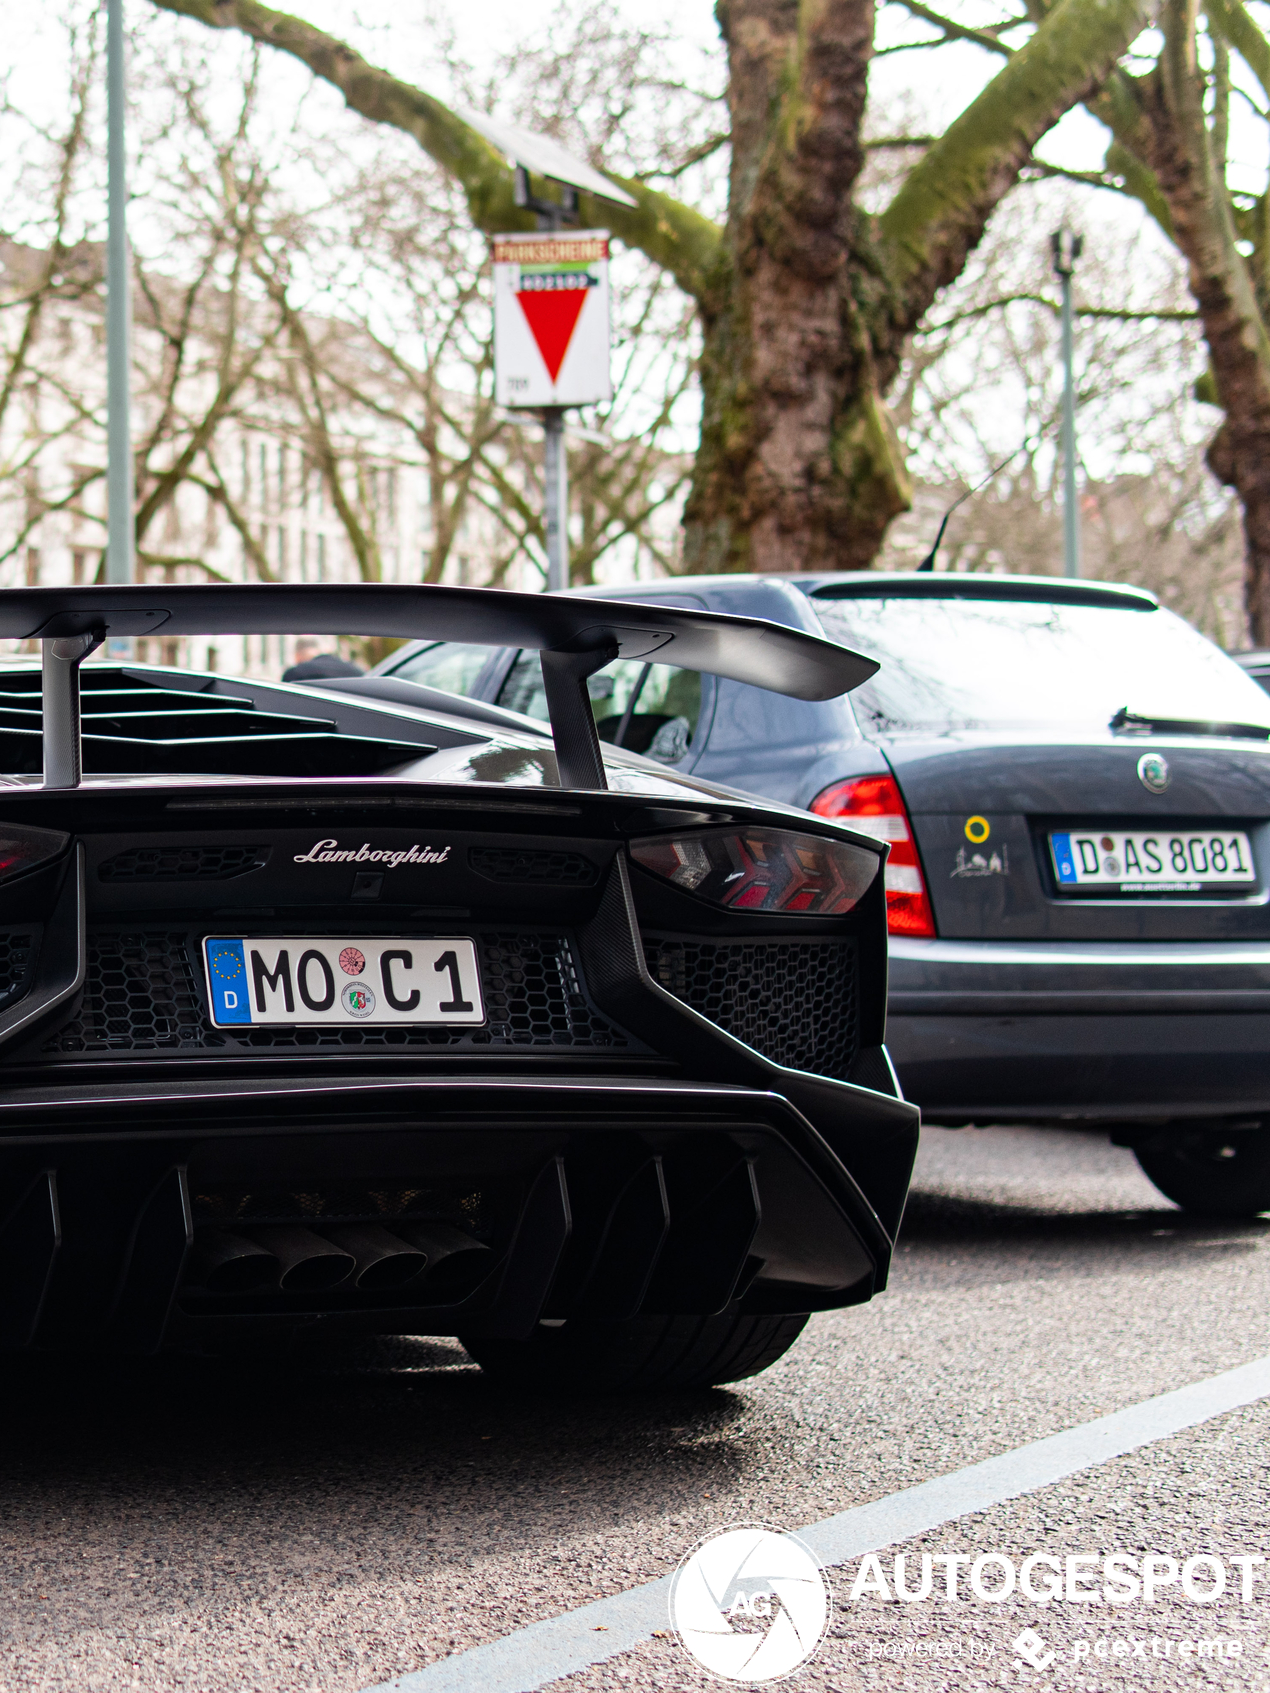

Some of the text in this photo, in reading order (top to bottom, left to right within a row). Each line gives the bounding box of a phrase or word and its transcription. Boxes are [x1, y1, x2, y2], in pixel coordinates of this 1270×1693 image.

[497, 241, 605, 262] PARKSCHEINE
[293, 839, 452, 868] Lamborghini
[1076, 837, 1248, 875] D AS 8081
[1061, 862, 1072, 876] D
[250, 949, 474, 1013] MO C 1
[223, 990, 238, 1009] D
